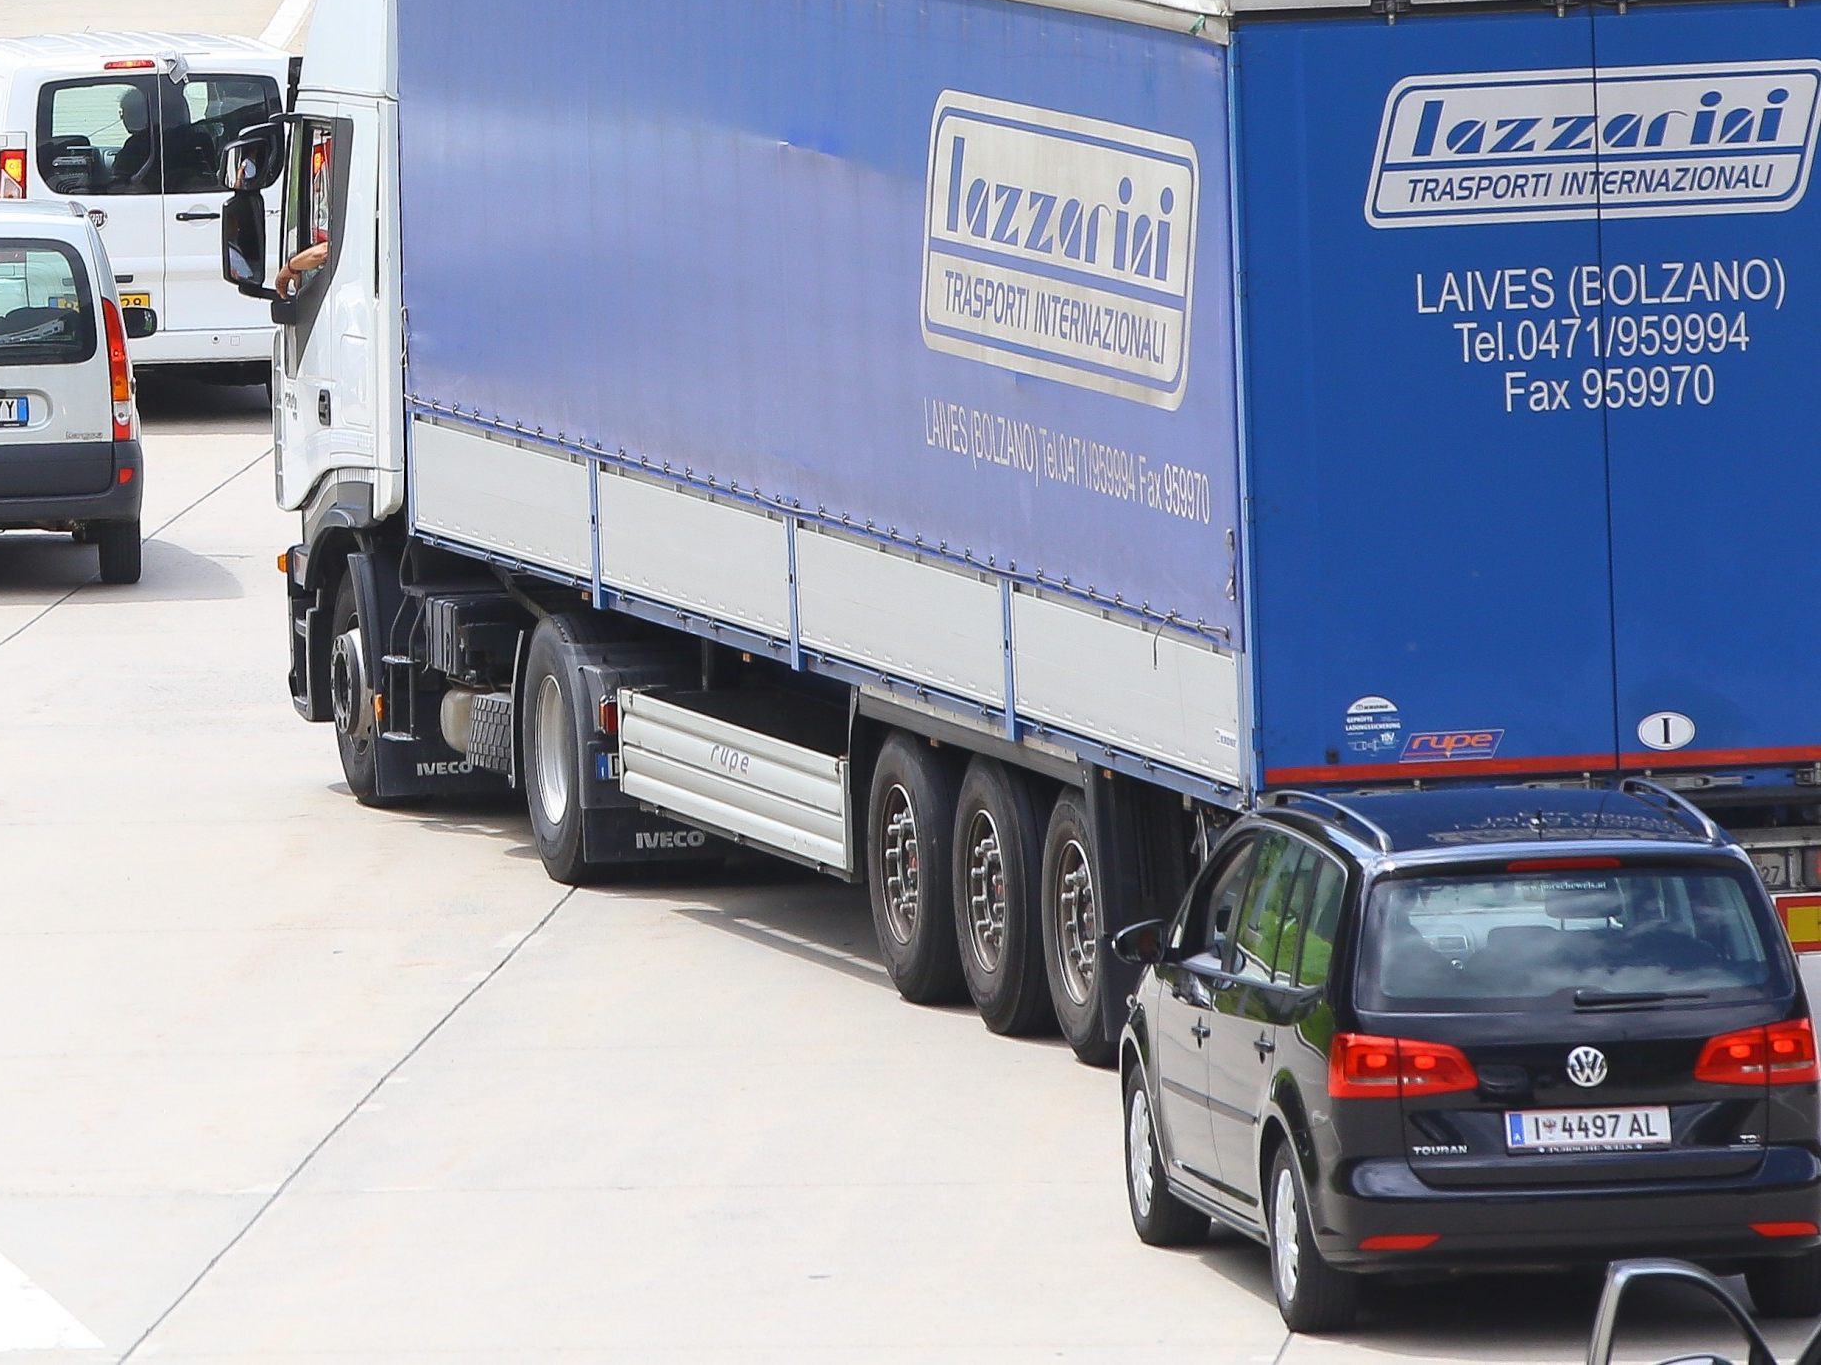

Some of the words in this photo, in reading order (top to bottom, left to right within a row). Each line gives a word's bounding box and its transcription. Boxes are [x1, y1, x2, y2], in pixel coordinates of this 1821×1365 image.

[1407, 171, 1554, 204] TRASPORTI
[1559, 163, 1775, 198] INTERNAZIONALI
[1415, 267, 1556, 315] LAIVES
[1568, 257, 1787, 318] (BOLZANO)
[945, 269, 1030, 331] TRASPORTI
[1034, 290, 1167, 365] INTERNAZIONALI
[1453, 311, 1750, 363] Tel.0471/959994
[1504, 370, 1571, 412] Fax
[1582, 363, 1715, 409] 959970
[923, 397, 969, 456] LAIVES
[970, 408, 1040, 488] (BOLZANO)
[1038, 426, 1137, 503] Tel.0471/959994
[1138, 454, 1163, 510] Fax
[1163, 462, 1212, 525] 959970
[1411, 733, 1493, 753] rupe
[1661, 718, 1671, 744] I
[415, 761, 474, 777] IVECO
[709, 743, 750, 775] rupe
[635, 830, 706, 849] IVECO
[1534, 1117, 1540, 1140] I
[1561, 1113, 1621, 1138] 4497
[1628, 1113, 1658, 1137] AL
[1412, 1145, 1468, 1155] TOURAN
